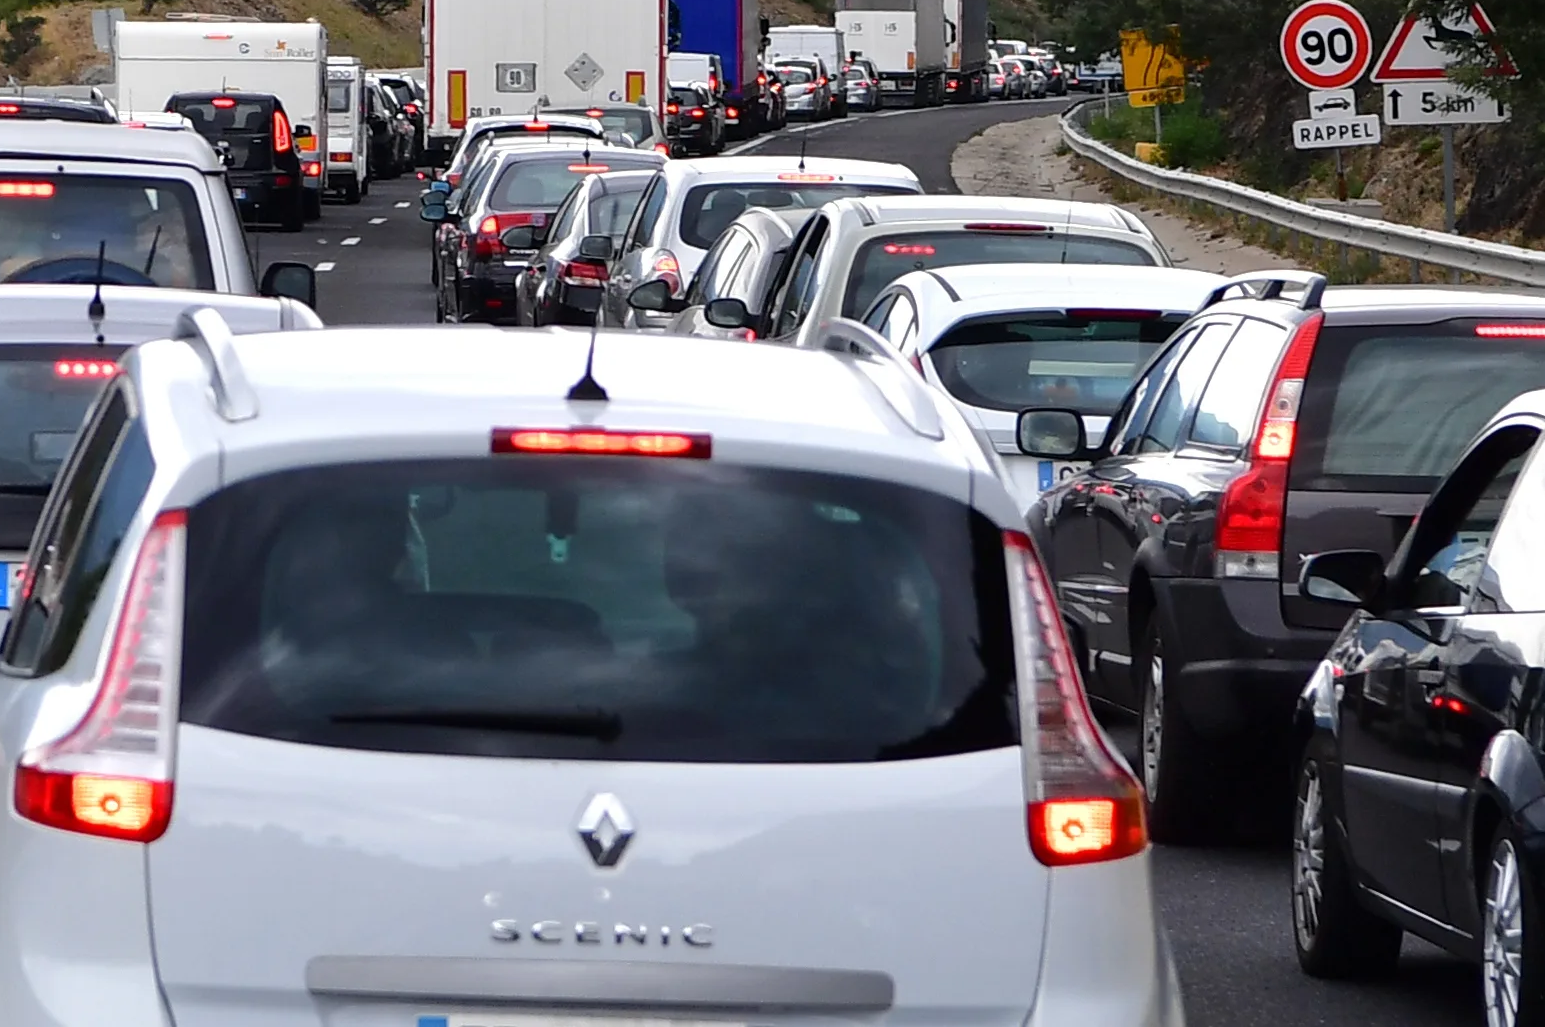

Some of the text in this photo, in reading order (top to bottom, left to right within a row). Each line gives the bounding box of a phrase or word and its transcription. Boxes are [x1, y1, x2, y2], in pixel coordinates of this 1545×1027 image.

[286, 48, 315, 58] Roller
[1301, 27, 1354, 66] 90
[509, 70, 522, 86] 90
[1421, 92, 1475, 114] 5 km
[1300, 122, 1374, 142] RAPPEL
[491, 919, 713, 948] SCENIC
